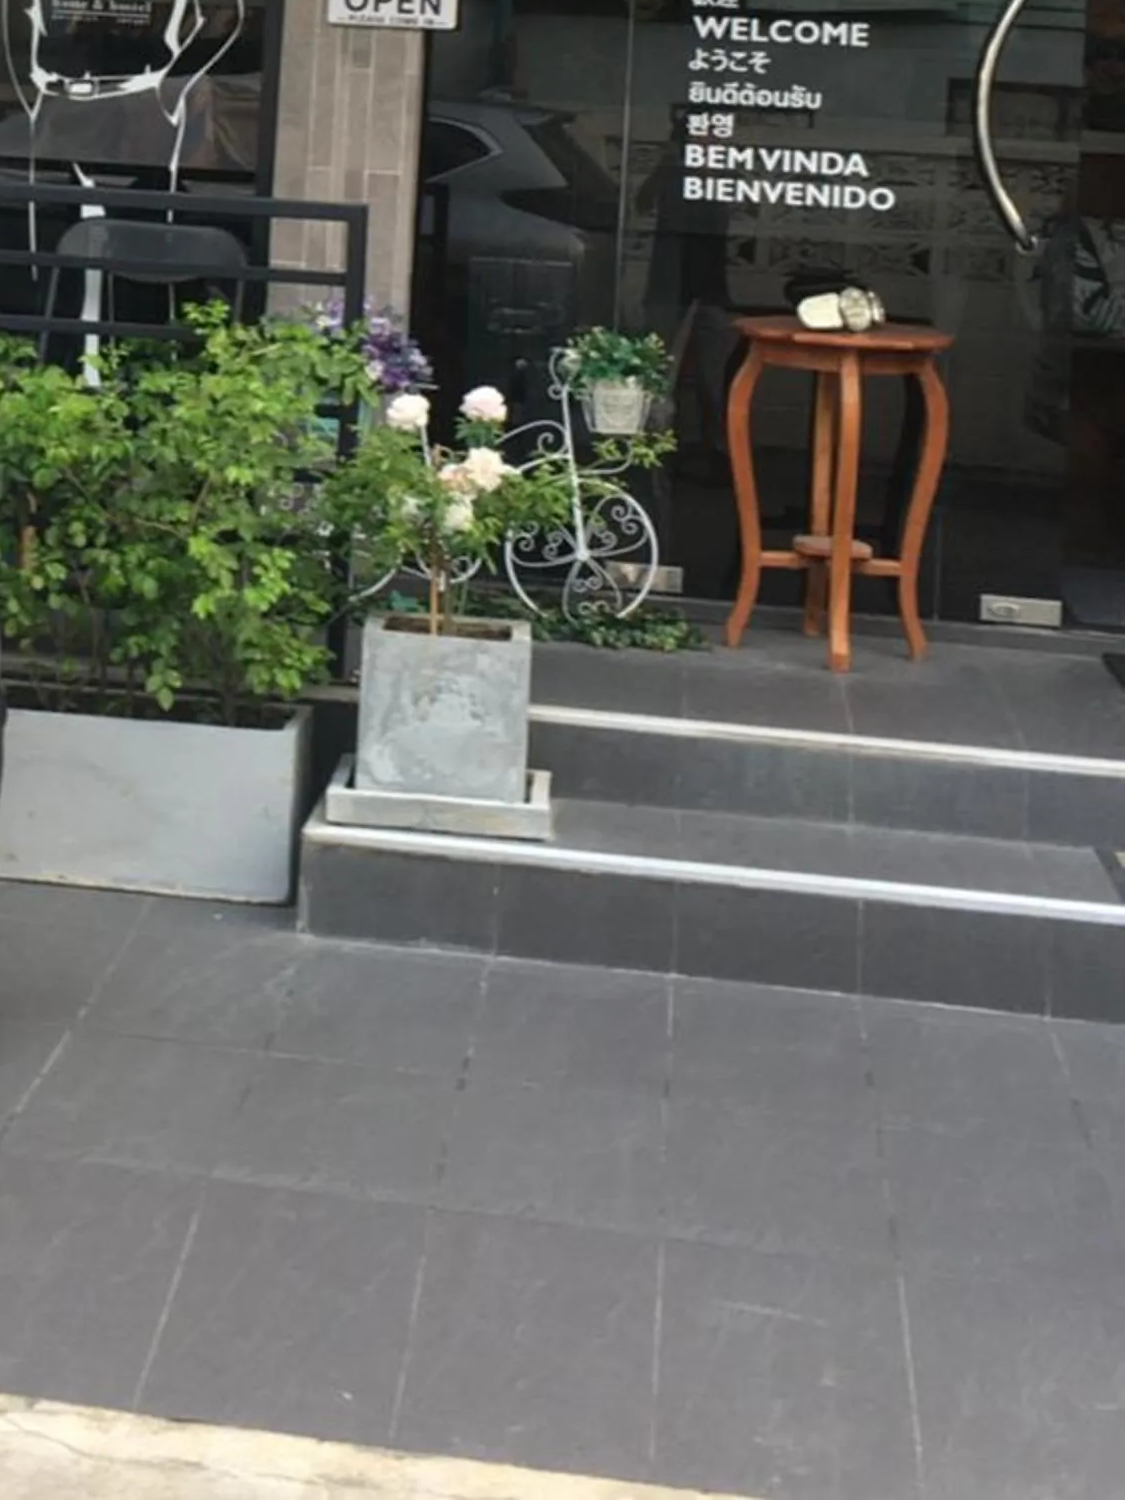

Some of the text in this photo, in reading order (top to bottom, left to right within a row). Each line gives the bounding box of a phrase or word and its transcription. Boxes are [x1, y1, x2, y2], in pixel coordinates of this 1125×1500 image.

[693, 15, 870, 47] WELCOME
[688, 48, 772, 74] ようこそ
[688, 81, 823, 109] ยินดีต้อนรับ
[684, 144, 869, 178] BEM VINDA
[683, 176, 896, 211] BIENVENIDO
